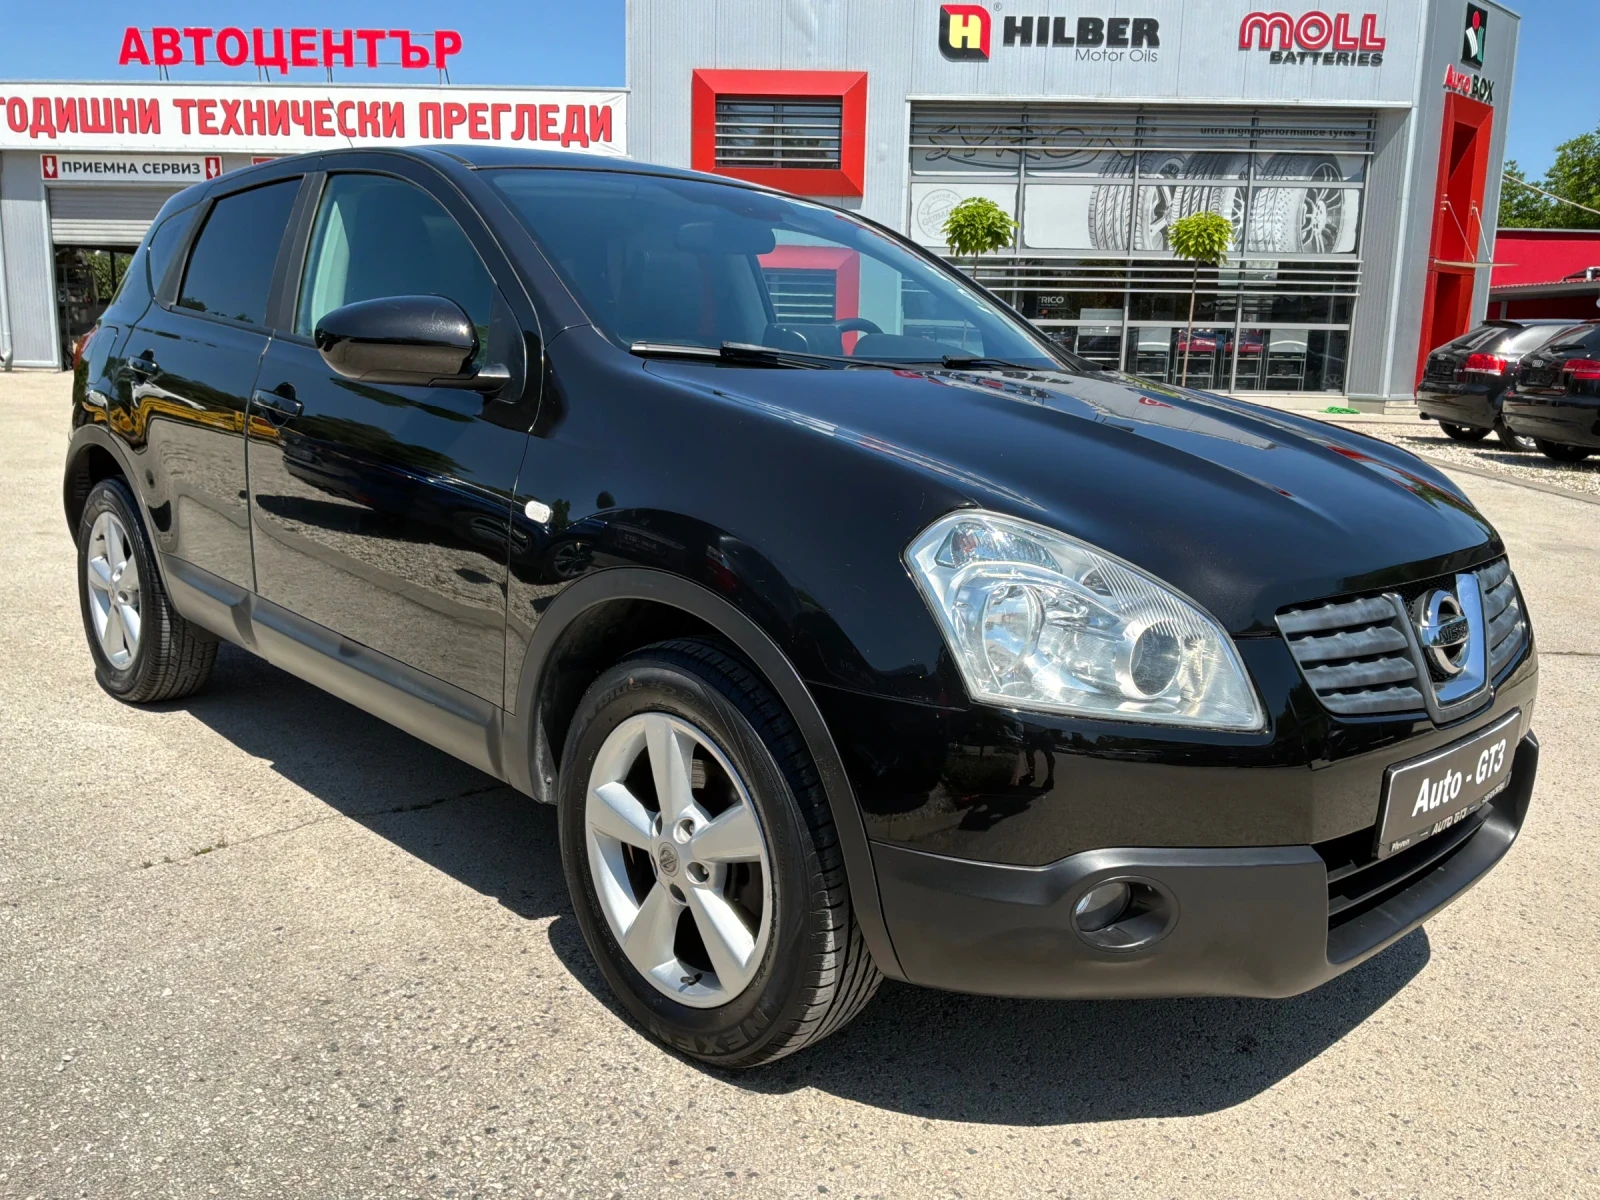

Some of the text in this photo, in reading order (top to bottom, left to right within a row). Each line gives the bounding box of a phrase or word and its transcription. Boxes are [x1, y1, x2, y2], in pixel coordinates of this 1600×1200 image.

[1002, 16, 1160, 48] HILBER
[118, 26, 462, 75] АВТОЦЕНТЪР
[1075, 49, 1158, 63] Motor Oils
[1269, 51, 1383, 67] BATTERIES
[0, 96, 612, 148] ОДИШНИ ТЕХНИЧЕСКИ ПРЕГЛЕДИ
[62, 161, 201, 175] ПРИЕМНА СЕРВИЗ
[1411, 768, 1463, 818] Auto
[1475, 738, 1507, 785] GT3
